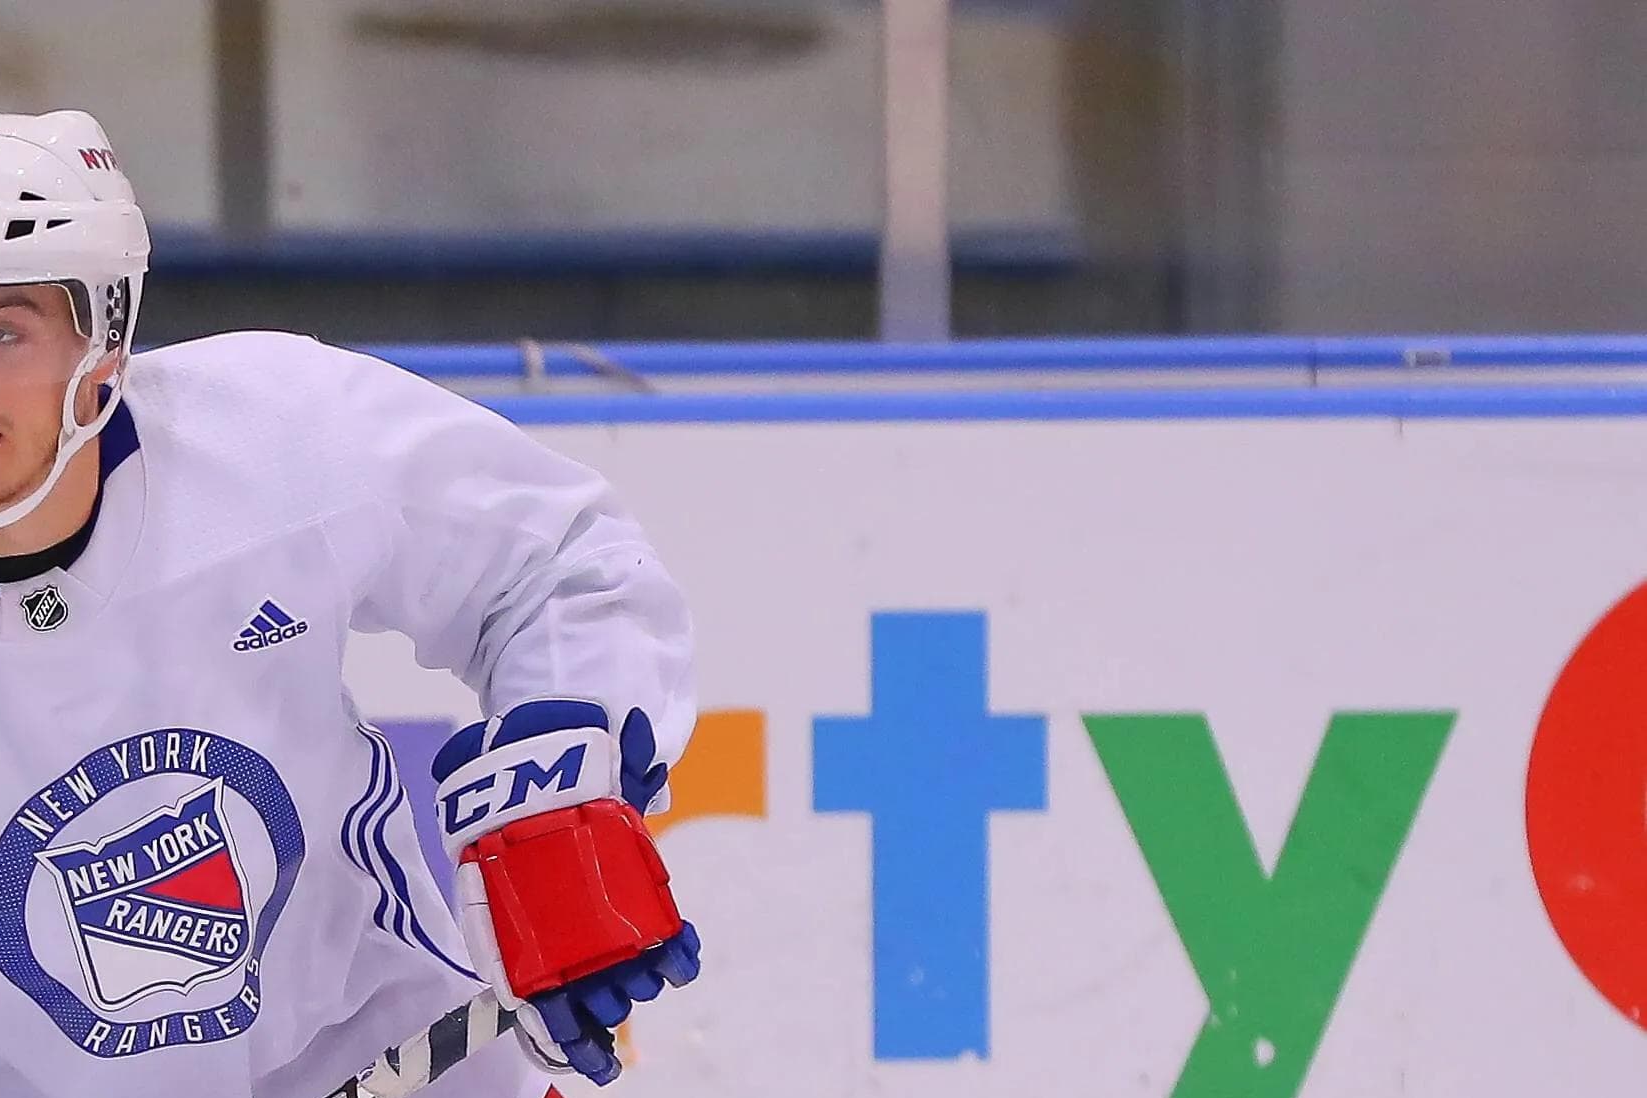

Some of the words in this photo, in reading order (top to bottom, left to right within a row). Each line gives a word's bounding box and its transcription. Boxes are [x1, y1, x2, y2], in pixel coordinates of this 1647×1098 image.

[35, 595, 56, 626] NHL
[233, 620, 308, 651] adidas
[16, 766, 97, 841] NEW
[109, 732, 211, 780] YORK
[436, 742, 588, 836] CM
[66, 852, 136, 898] NEW
[143, 812, 220, 872] YORK
[105, 898, 242, 955] RANGERS
[84, 957, 261, 1054] RANGERS
